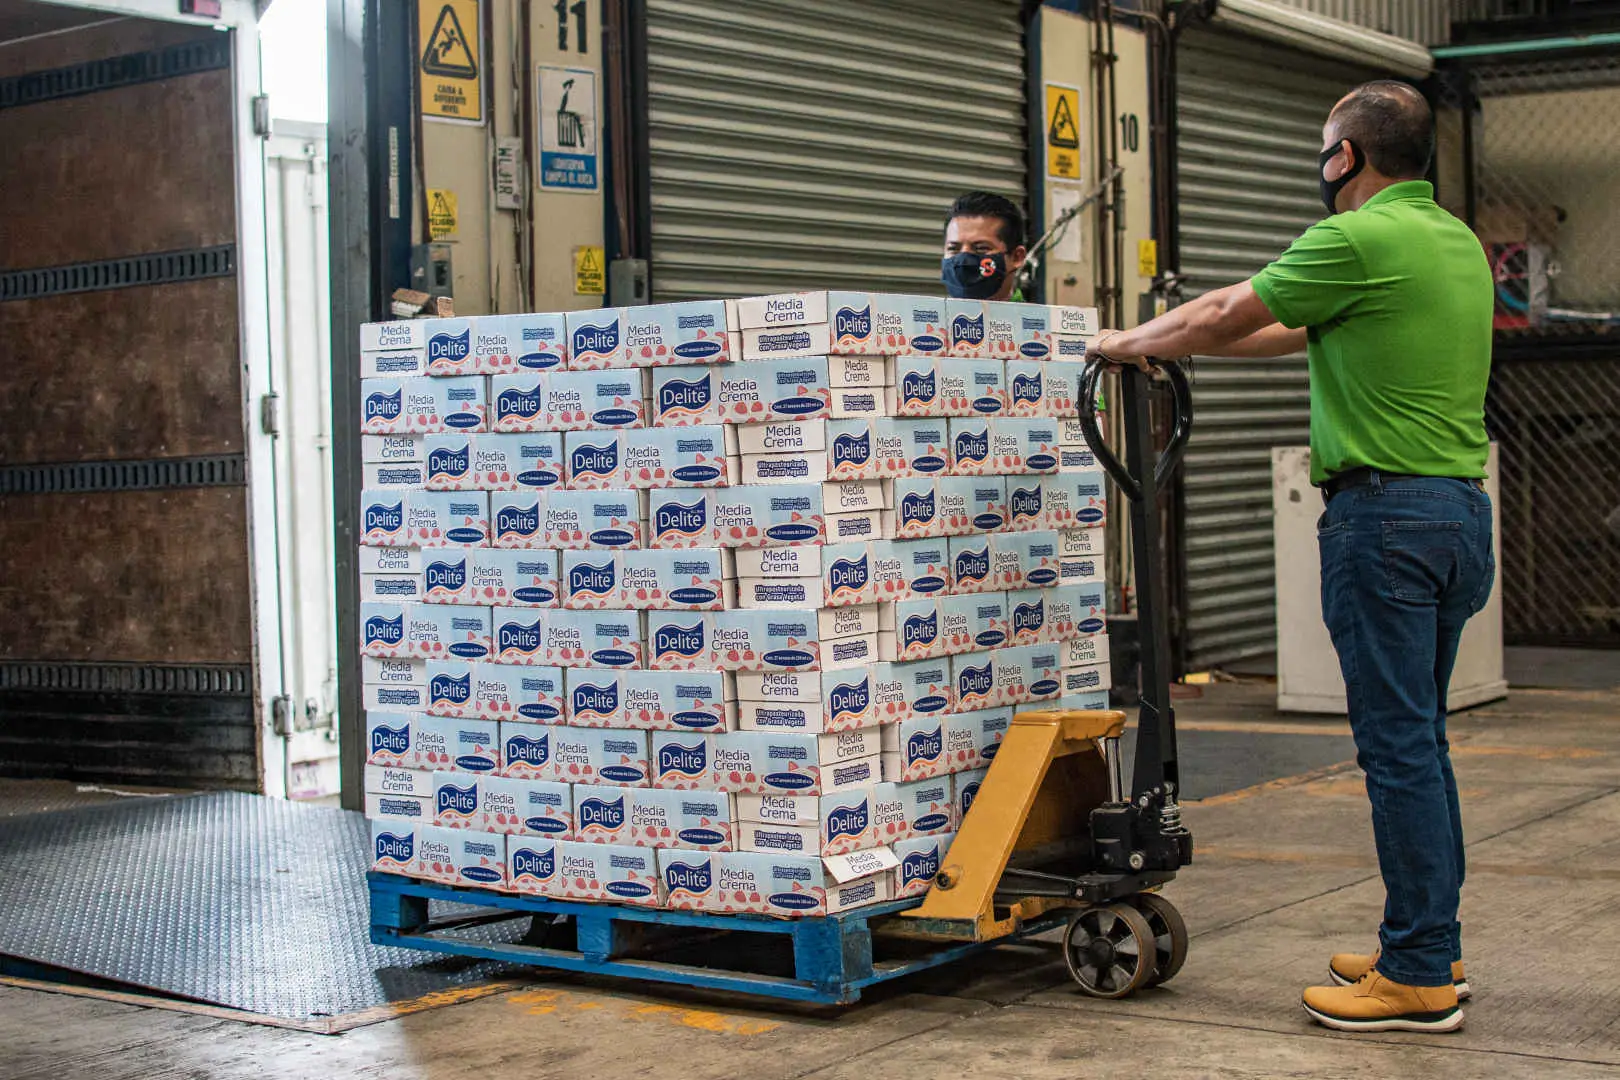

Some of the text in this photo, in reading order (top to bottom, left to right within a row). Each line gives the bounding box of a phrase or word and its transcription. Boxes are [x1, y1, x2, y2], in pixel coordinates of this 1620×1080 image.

[553, 0, 587, 53] 11
[1119, 113, 1138, 152] 10
[767, 299, 803, 311] Media
[765, 311, 804, 322] Crema
[877, 314, 901, 324] Media
[1062, 311, 1084, 321] Media
[628, 324, 660, 336] Media
[839, 316, 868, 333] Delite
[877, 325, 902, 335] Crema
[1062, 321, 1086, 330] Crema
[381, 326, 410, 335] Media
[955, 324, 981, 339] Delite
[379, 335, 411, 345] Crema
[478, 336, 506, 345] Media
[577, 334, 614, 349] Delite
[626, 335, 662, 347] Crema
[432, 342, 465, 356] Delite
[476, 345, 508, 355] Crema
[845, 360, 867, 371] Media
[845, 371, 870, 382] Crema
[721, 380, 756, 391] Media
[906, 381, 933, 396] Delite
[408, 395, 433, 405] Media
[550, 391, 579, 401] Media
[664, 389, 706, 405] Delite
[719, 392, 758, 402] Crema
[368, 401, 399, 414] Delite
[407, 405, 435, 414] Crema
[501, 397, 536, 412] Delite
[548, 402, 581, 411] Crema
[766, 426, 800, 436] Media
[384, 438, 413, 448] Media
[764, 436, 802, 448] Crema
[382, 448, 414, 458] Crema
[627, 448, 660, 457] Media
[837, 443, 867, 459] Delite
[958, 441, 985, 456] Delite
[477, 451, 505, 461] Media
[576, 454, 613, 469] Delite
[432, 457, 465, 471] Delite
[475, 461, 506, 471] Crema
[625, 458, 660, 468] Crema
[840, 486, 864, 495] Media
[840, 496, 867, 507] Crema
[410, 508, 435, 517] Media
[548, 511, 577, 520] Media
[716, 505, 751, 516] Media
[368, 511, 399, 526] Delite
[408, 518, 437, 528] Crema
[501, 515, 535, 530] Delite
[660, 512, 701, 528] Delite
[714, 516, 753, 526] Crema
[545, 520, 578, 530] Crema
[380, 550, 408, 558] Media
[763, 551, 796, 561] Media
[378, 559, 408, 568] Crema
[761, 562, 799, 572] Crema
[959, 561, 985, 575] Delite
[429, 570, 461, 584] Delite
[474, 567, 501, 576] Media
[624, 568, 655, 578] Media
[833, 569, 864, 585] Delite
[472, 577, 503, 586] Crema
[573, 572, 610, 587] Delite
[622, 578, 657, 588] Crema
[835, 611, 859, 622] Media
[368, 624, 399, 638] Delite
[411, 621, 437, 631] Media
[835, 622, 861, 633] Crema
[906, 622, 934, 638] Delite
[409, 631, 438, 641] Crema
[502, 631, 536, 645] Delite
[549, 628, 579, 638] Media
[714, 629, 748, 639] Media
[548, 638, 580, 648] Crema
[659, 634, 699, 649] Delite
[712, 640, 750, 650] Crema
[1071, 640, 1094, 649] Media
[1070, 650, 1095, 660] Crema
[382, 662, 411, 671] Media
[380, 671, 412, 681] Crema
[764, 674, 797, 684] Media
[478, 681, 506, 691] Media
[876, 682, 902, 692] Media
[962, 676, 990, 690] Delite
[434, 682, 466, 698] Delite
[627, 690, 658, 700] Media
[761, 685, 798, 696] Crema
[477, 691, 507, 701] Crema
[577, 692, 613, 708] Delite
[875, 693, 903, 704] Crema
[625, 700, 660, 710] Crema
[833, 694, 865, 710] Delite
[375, 732, 405, 748] Delite
[417, 732, 444, 743] Media
[838, 732, 862, 745] Media
[416, 742, 445, 753] Crema
[509, 744, 544, 760] Delite
[557, 743, 587, 753] Media
[837, 744, 864, 757] Crema
[910, 740, 939, 756] Delite
[555, 753, 588, 763] Crema
[663, 752, 701, 768] Delite
[716, 750, 749, 760] Media
[714, 760, 751, 771] Crema
[384, 770, 412, 781] Media
[382, 780, 413, 791] Crema
[440, 792, 473, 809] Delite
[485, 793, 513, 804] Media
[762, 797, 795, 808] Media
[484, 803, 515, 814] Crema
[633, 805, 665, 816] Media
[876, 802, 902, 813] Media
[583, 807, 620, 822] Delite
[760, 808, 796, 820] Crema
[875, 813, 904, 825] Crema
[632, 816, 666, 826] Crema
[830, 814, 864, 832] Delite
[378, 840, 409, 856] Delite
[422, 841, 448, 852] Media
[420, 851, 450, 862] Crema
[563, 856, 593, 868] Media
[516, 856, 550, 872] Delite
[905, 862, 935, 877] Delite
[561, 866, 595, 878] Crema
[721, 868, 753, 880] Media
[670, 870, 707, 887] Delite
[719, 879, 755, 891] Crema
